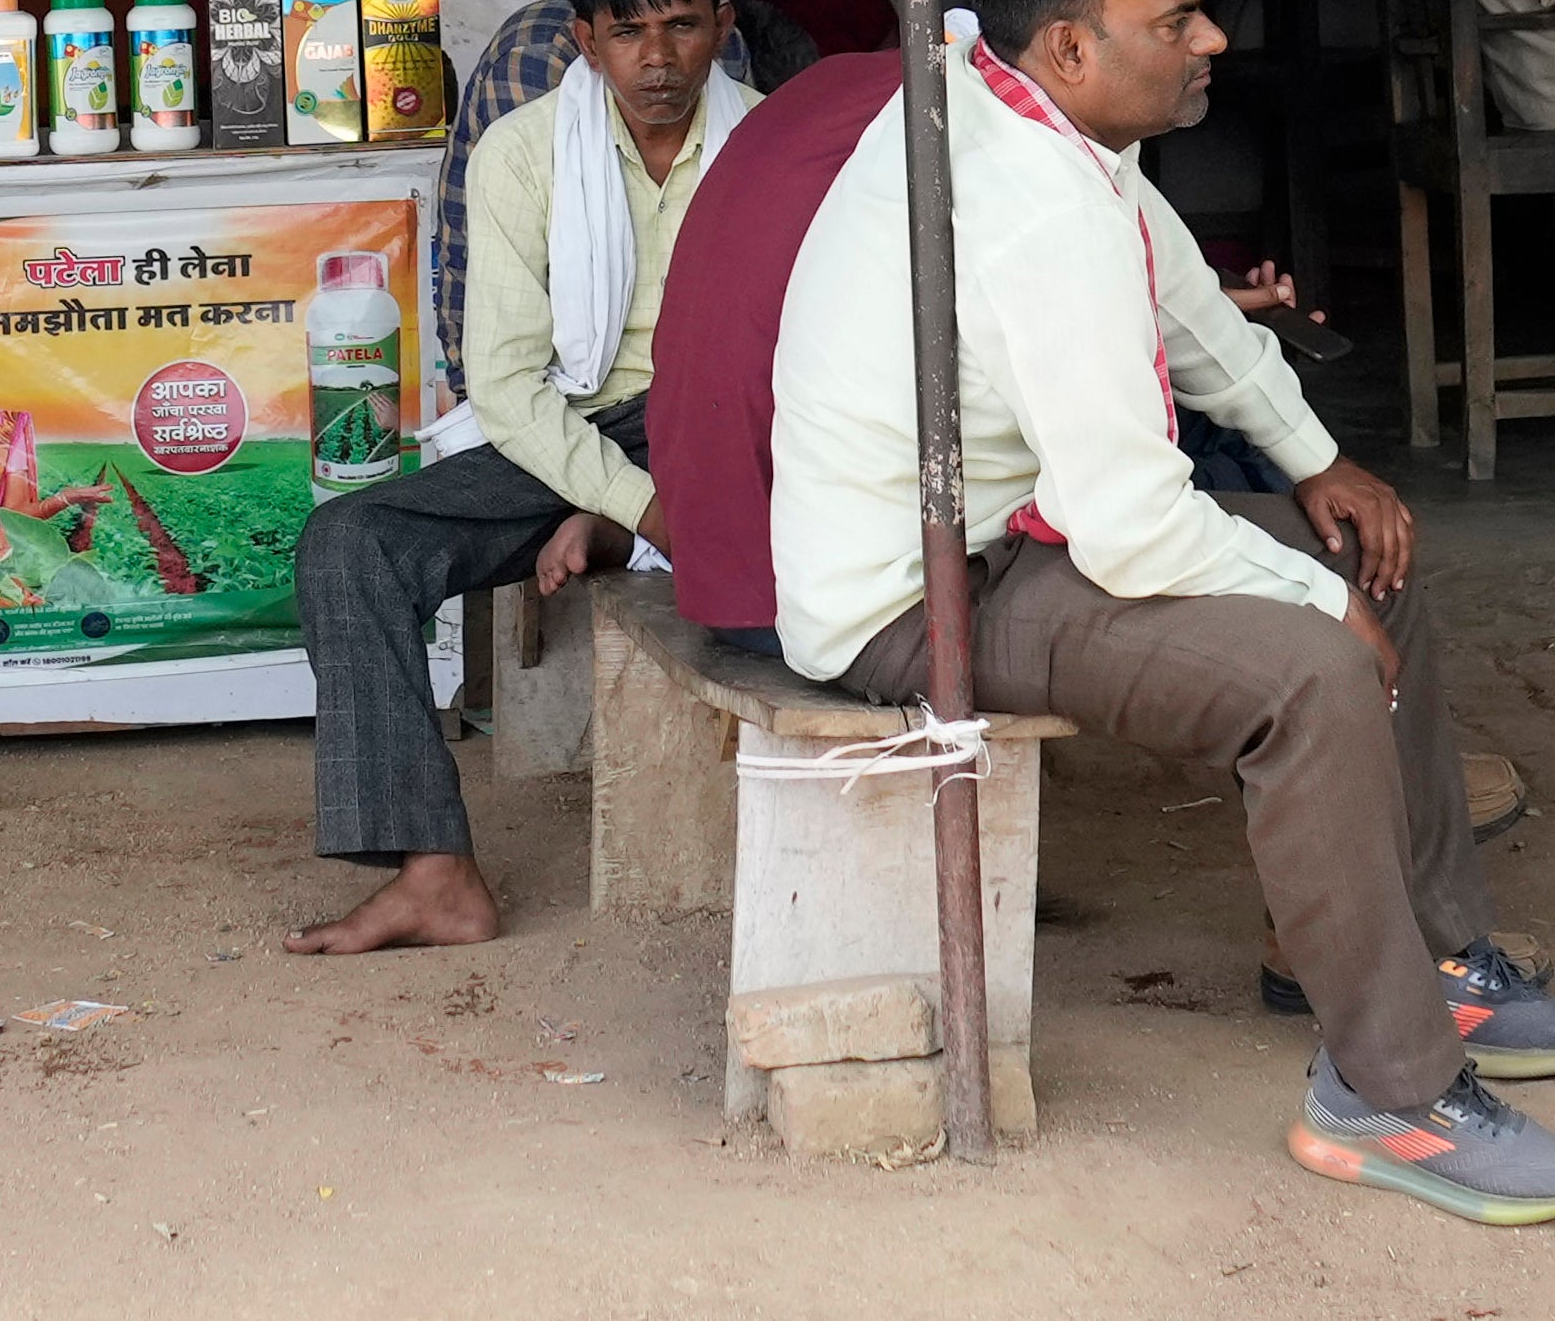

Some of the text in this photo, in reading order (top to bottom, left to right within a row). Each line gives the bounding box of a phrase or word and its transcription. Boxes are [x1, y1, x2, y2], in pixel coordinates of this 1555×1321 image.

[219, 9, 250, 23] BIO
[215, 23, 271, 40] HERBAL
[370, 20, 436, 36] DHANZYME
[24, 246, 252, 287] पटेला ही लेना
[136, 303, 190, 329] मत
[201, 299, 295, 327] करना
[327, 348, 383, 361] PATELA
[151, 379, 226, 400] आपका
[152, 401, 226, 418] जाँचा परखा
[153, 418, 228, 442] सर्वश्रेष्ठ
